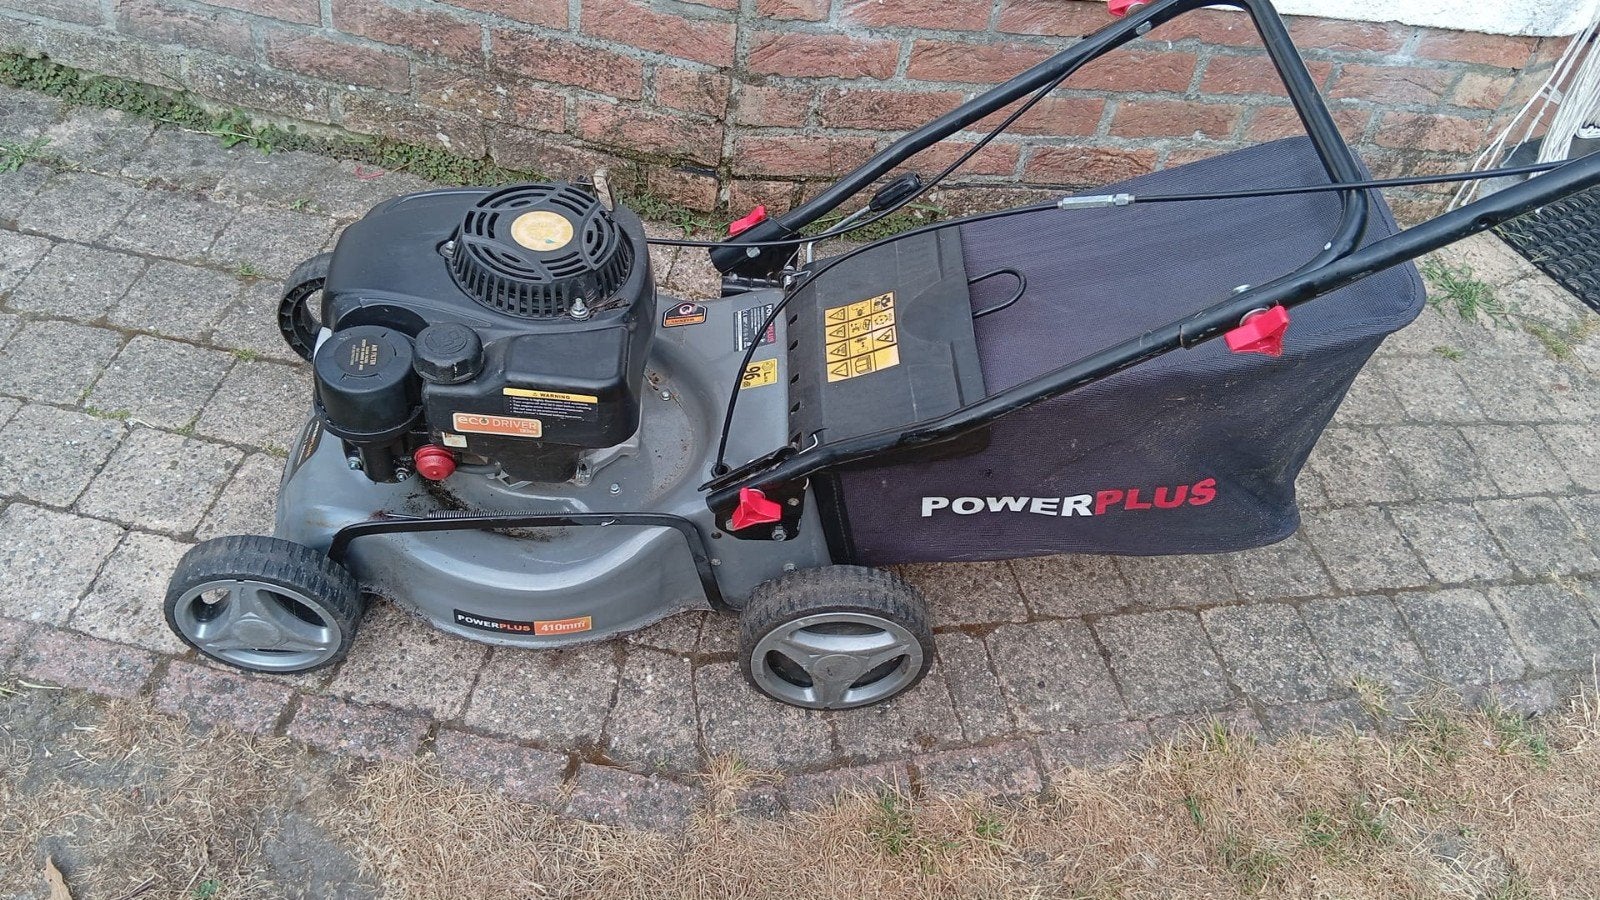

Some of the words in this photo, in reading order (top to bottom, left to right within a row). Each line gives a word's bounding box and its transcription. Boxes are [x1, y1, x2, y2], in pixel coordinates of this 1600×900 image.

[743, 366, 760, 381] 96
[540, 392, 570, 400] WARNING
[493, 418, 537, 430] DRIVER
[921, 477, 1217, 517] POWERPLUS
[457, 614, 531, 632] POWERPLUS
[541, 620, 586, 632] 410mm
